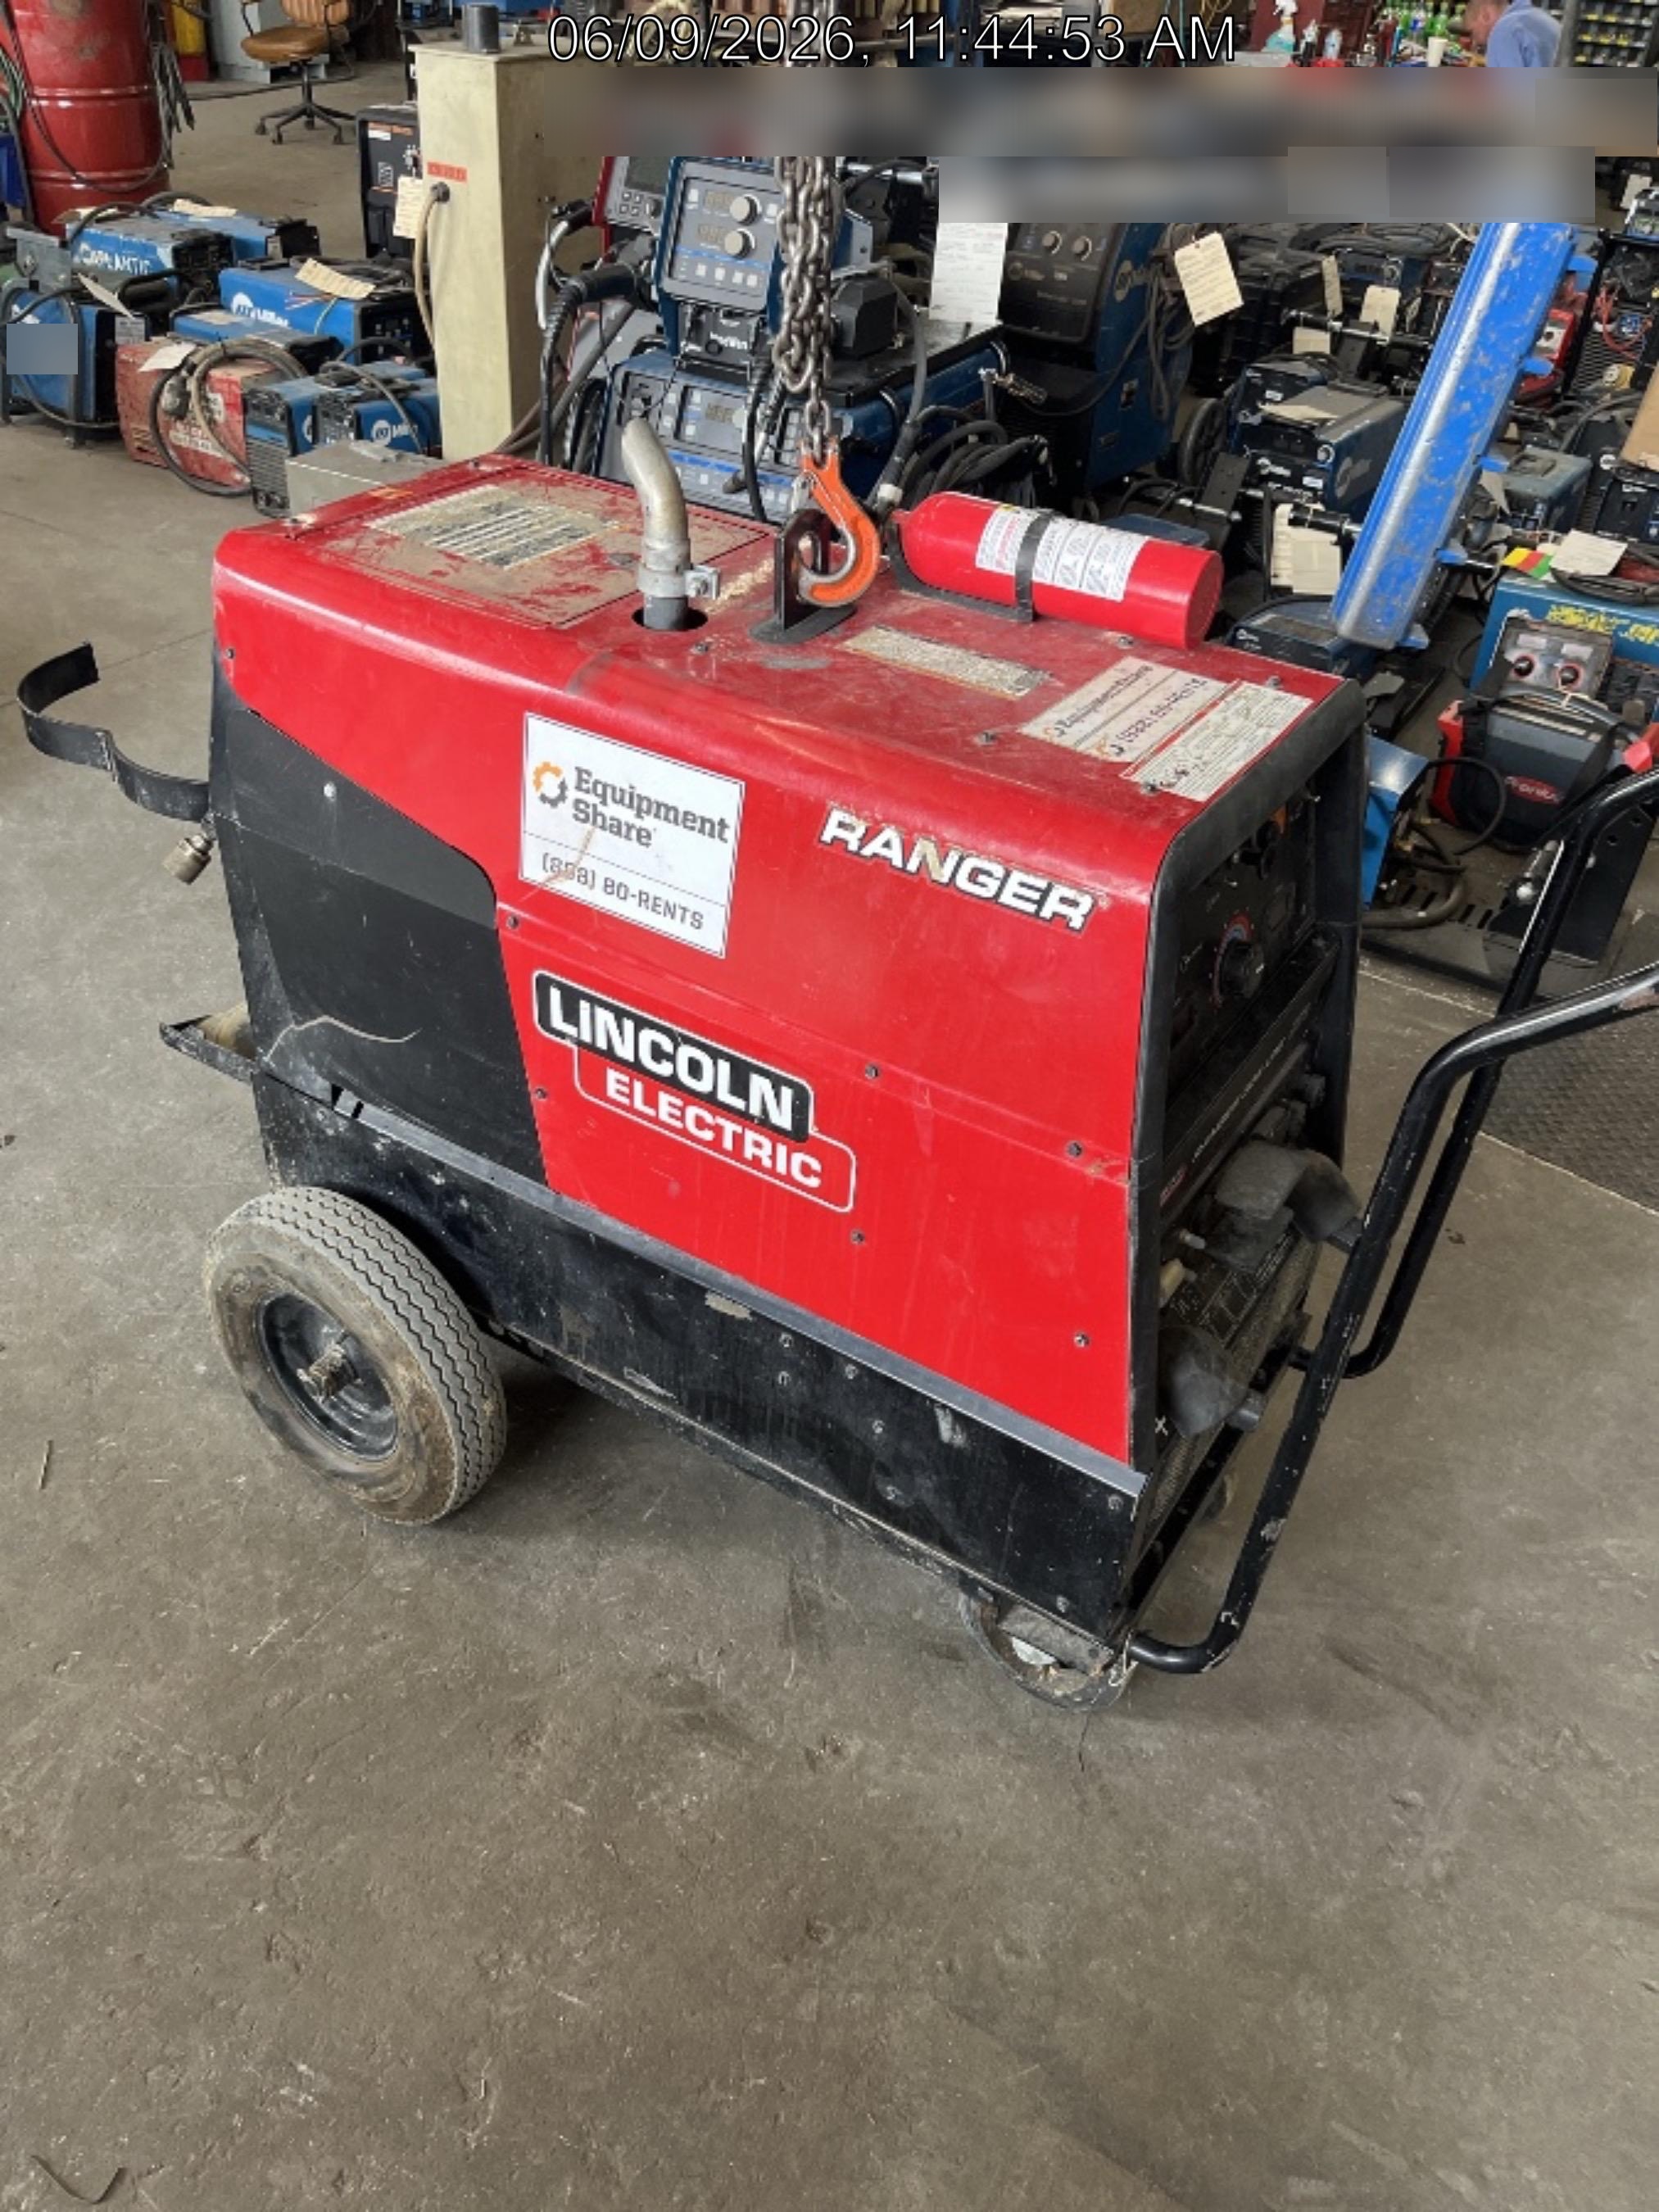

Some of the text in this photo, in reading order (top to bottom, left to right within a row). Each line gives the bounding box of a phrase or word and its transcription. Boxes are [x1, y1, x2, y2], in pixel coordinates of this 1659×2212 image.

[572, 797, 653, 849] Share
[574, 765, 731, 844] Equipment
[602, 876, 705, 931] 80-RENTS
[819, 805, 1096, 933] RANGER
[549, 984, 794, 1132] LINCOLN
[605, 1066, 823, 1189] ELECTRIC
